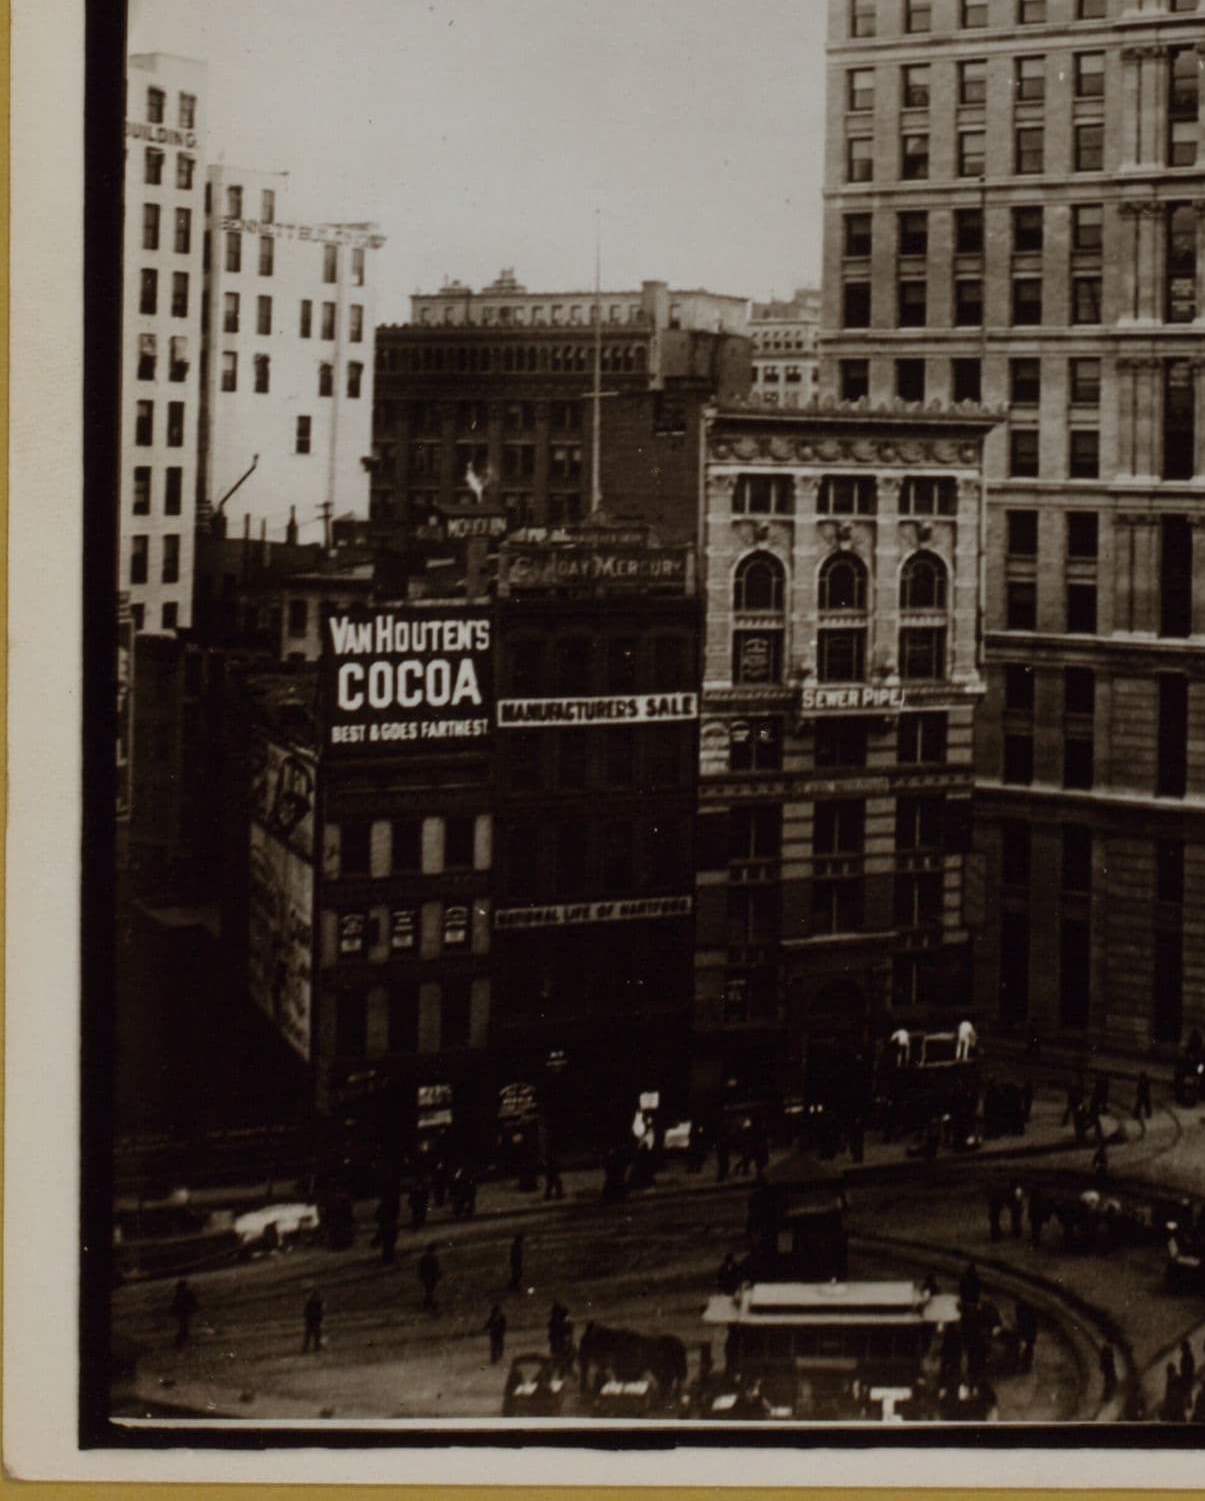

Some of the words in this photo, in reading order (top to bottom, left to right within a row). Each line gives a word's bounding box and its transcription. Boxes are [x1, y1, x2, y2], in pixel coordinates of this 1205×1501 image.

[592, 554, 682, 579] MERCURY
[328, 615, 373, 655] VAN
[375, 614, 491, 653] HOUTEN'S
[337, 657, 483, 712] COCOA
[646, 695, 693, 717] SALE
[802, 688, 859, 709] SEWER
[862, 686, 902, 708] PIPE
[331, 724, 367, 744] BEST
[381, 721, 418, 740] GOES
[421, 718, 489, 739] FARTHEST
[563, 905, 591, 923] LIFE
[596, 904, 614, 920] OF
